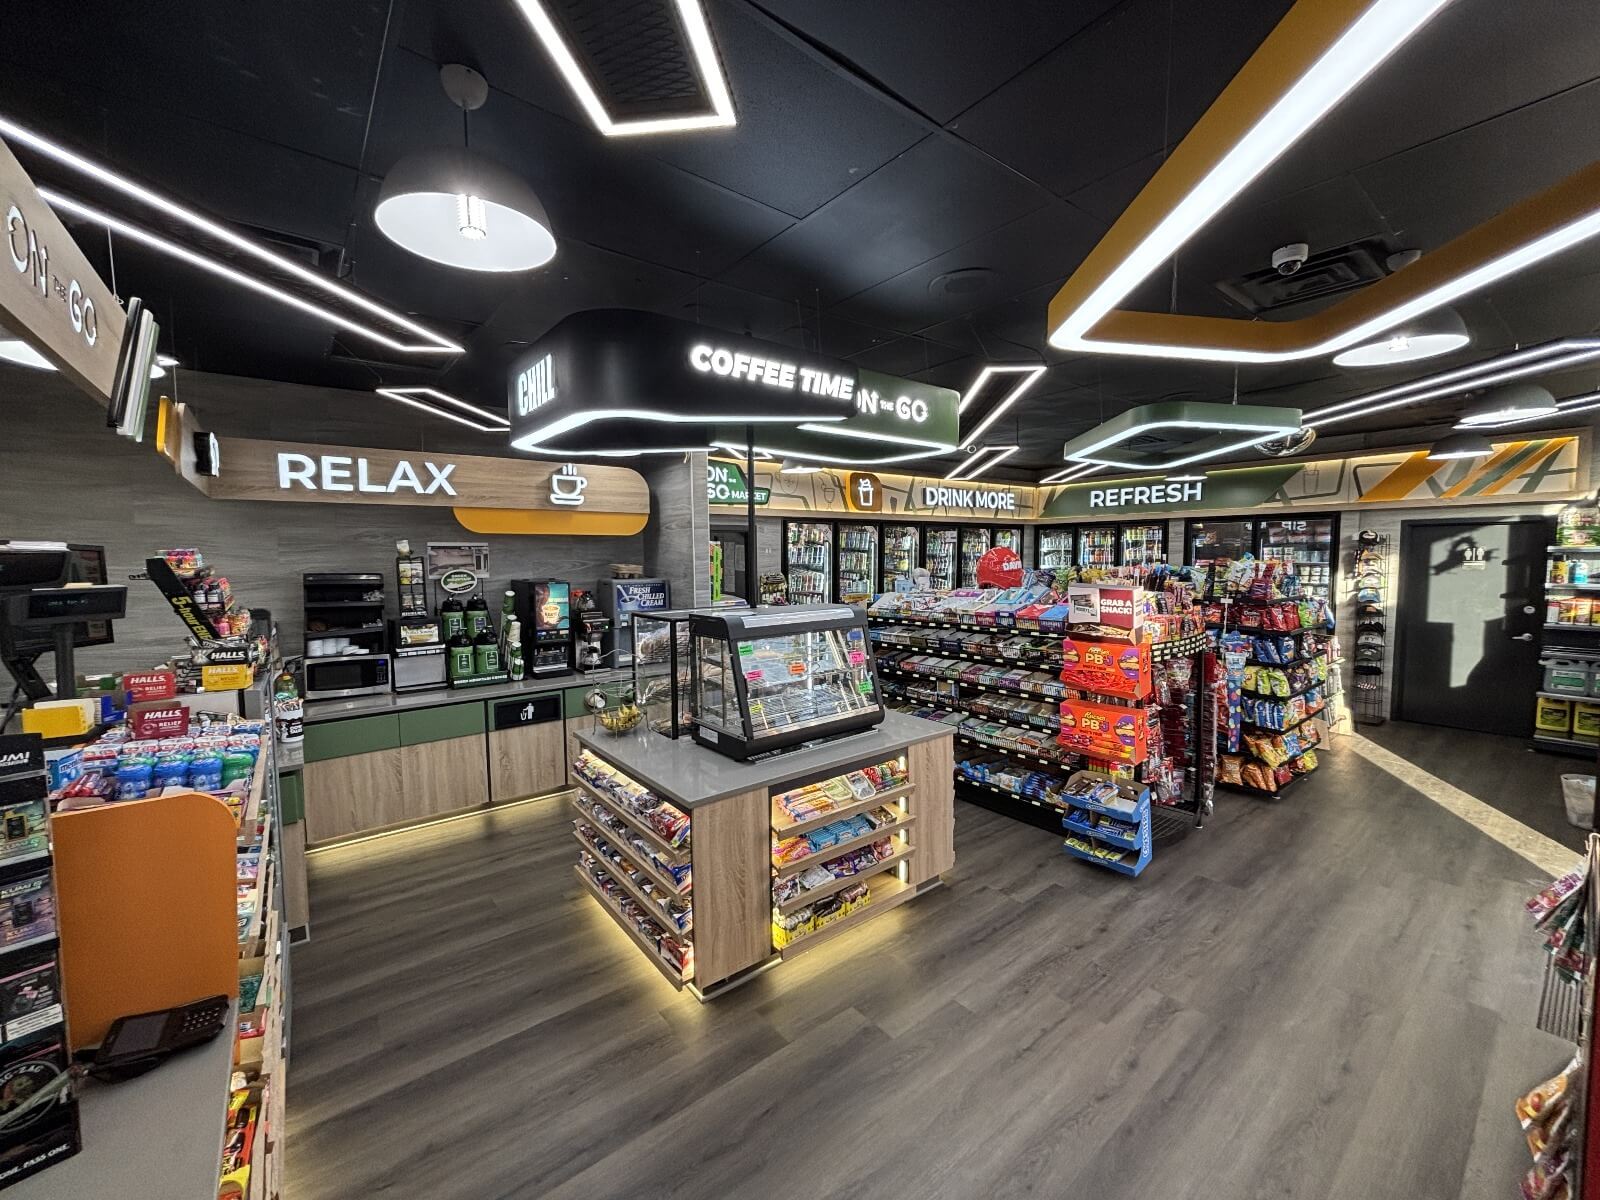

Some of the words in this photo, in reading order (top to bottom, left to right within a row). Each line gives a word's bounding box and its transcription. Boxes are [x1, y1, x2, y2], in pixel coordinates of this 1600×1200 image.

[7, 206, 48, 298] ON
[69, 280, 96, 346] GO
[691, 345, 797, 388] COFFEE
[799, 367, 855, 400] TIME
[519, 353, 555, 416] CHILL
[896, 396, 928, 422] GO
[277, 453, 457, 496] RELAX
[926, 487, 974, 508] DRINK
[975, 490, 1015, 510] MORE
[1090, 482, 1202, 508] REFRESH
[629, 586, 650, 594] FRESH
[1101, 599, 1123, 607] GRAB
[1101, 606, 1132, 615] SNACK!
[211, 651, 245, 659] HALLS
[208, 666, 239, 674] HALLS
[130, 675, 166, 684] HALLS
[144, 709, 182, 719] HALLS
